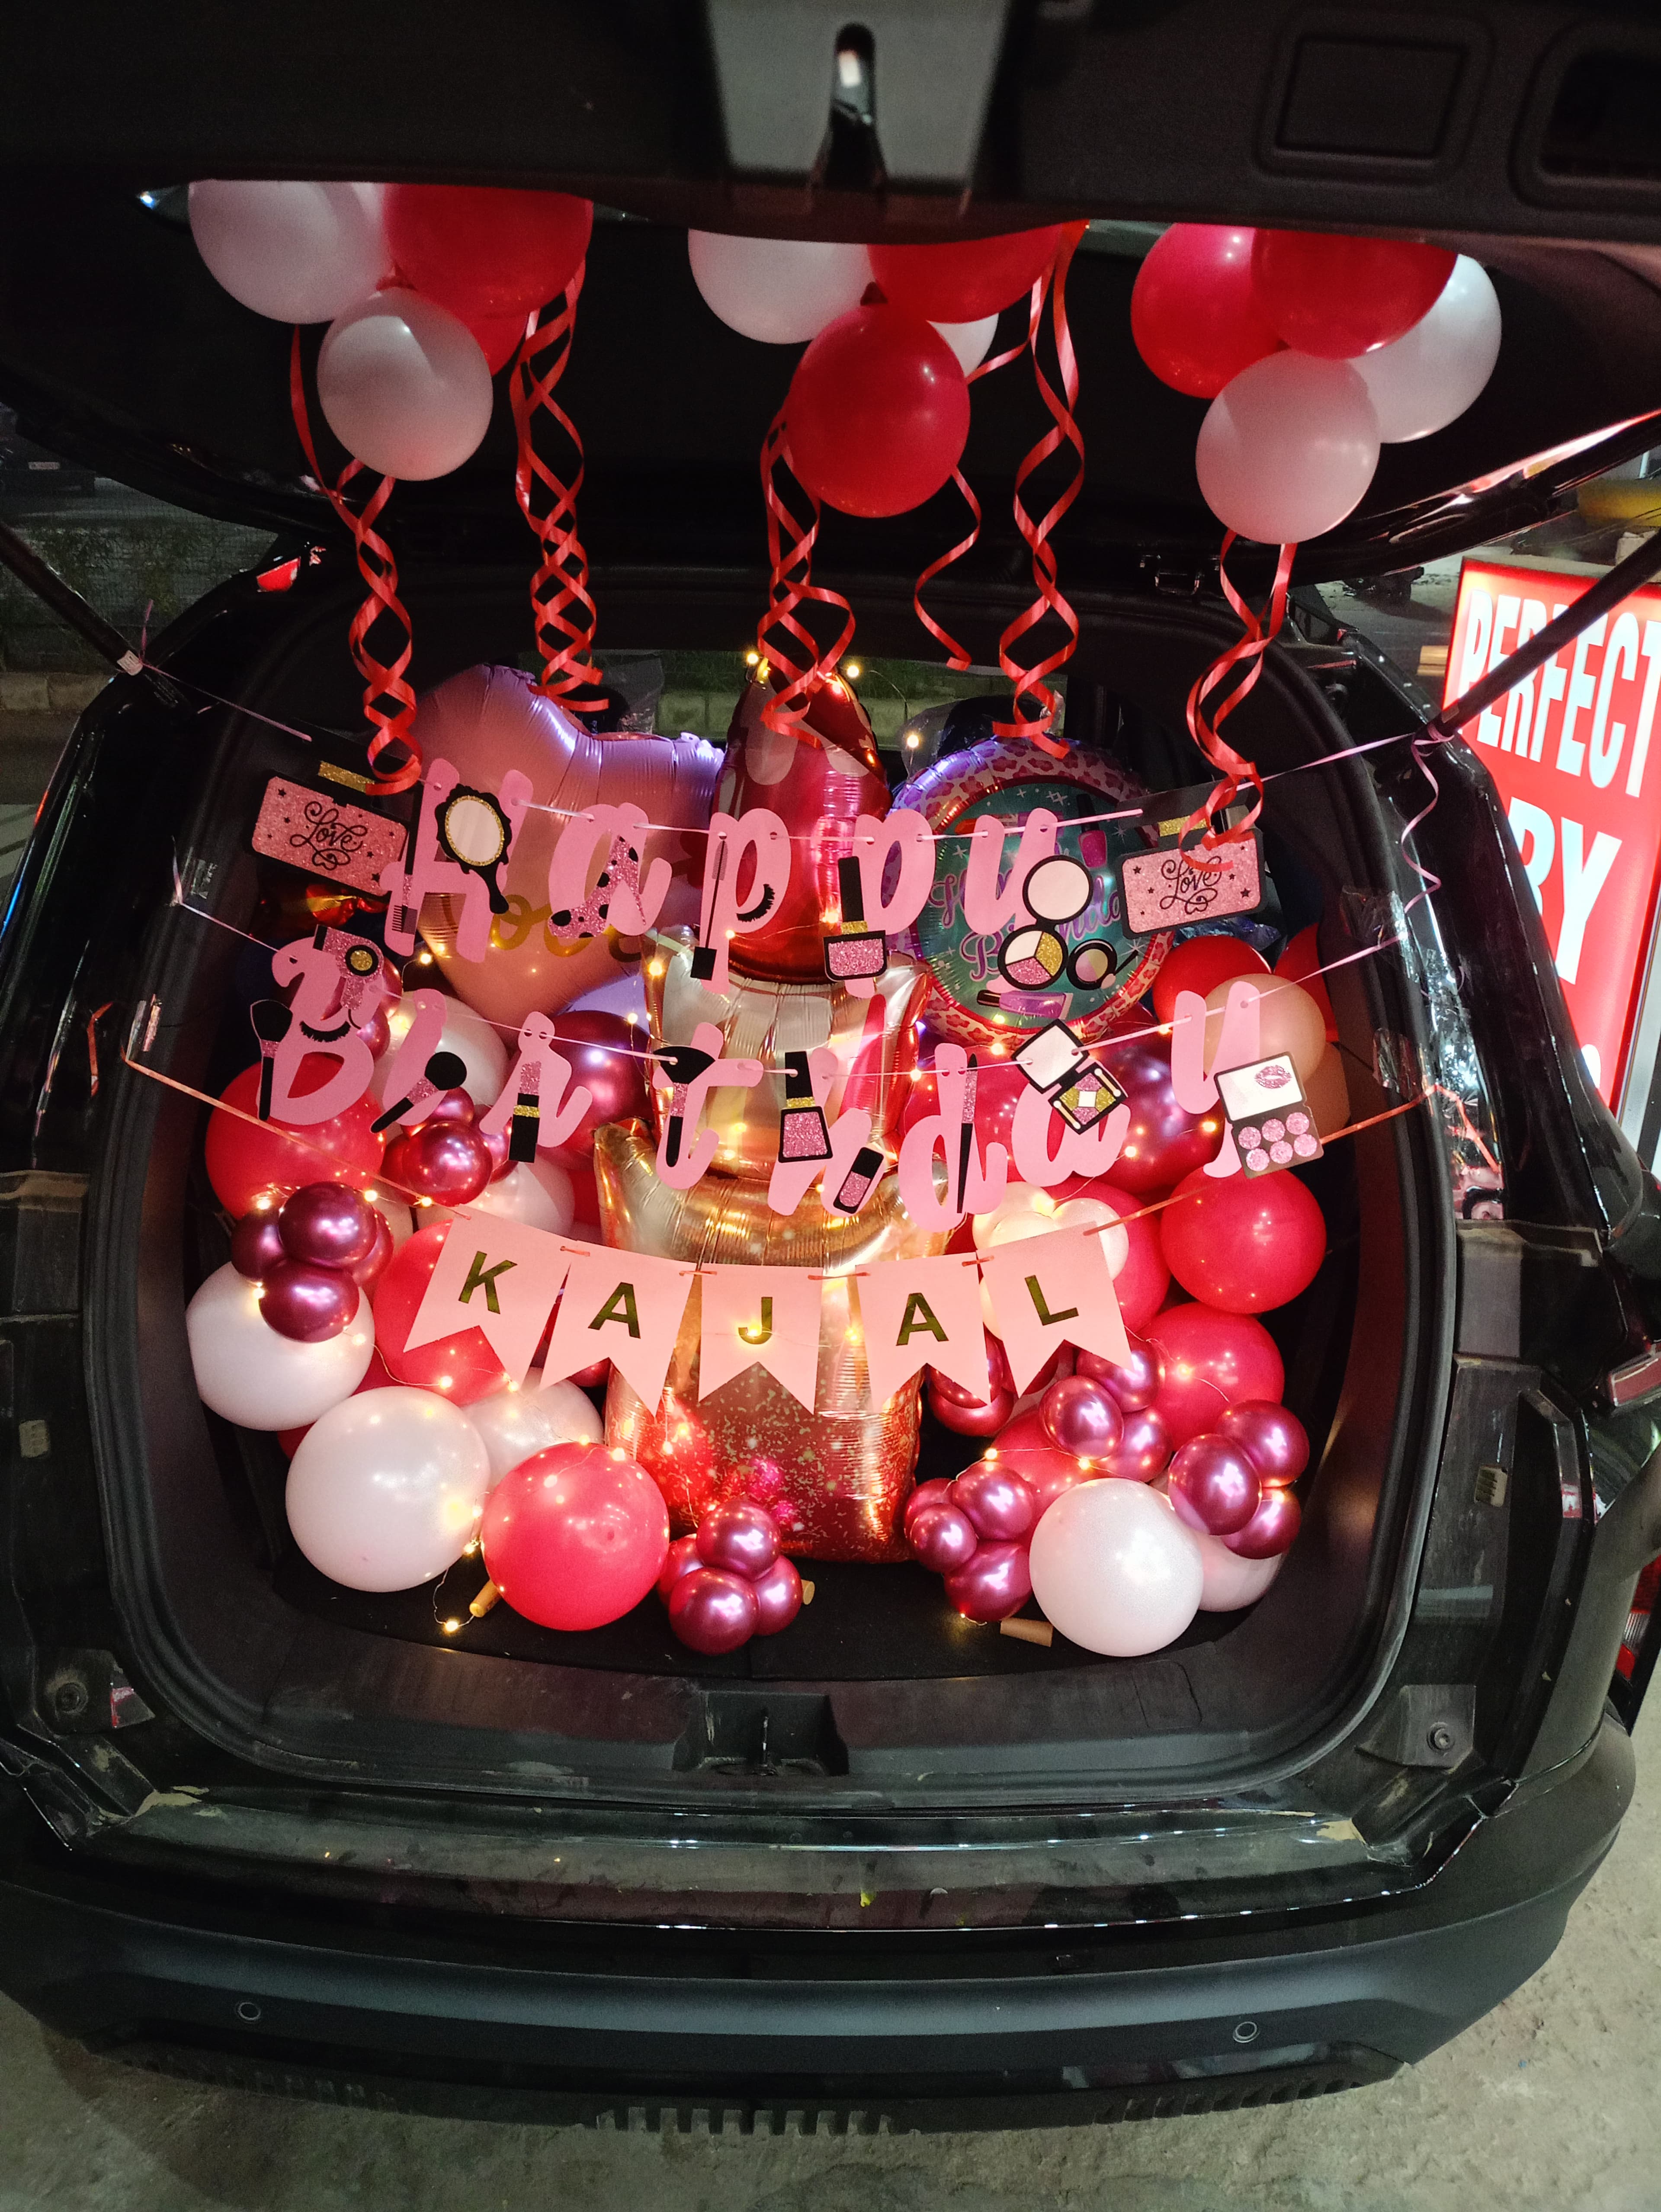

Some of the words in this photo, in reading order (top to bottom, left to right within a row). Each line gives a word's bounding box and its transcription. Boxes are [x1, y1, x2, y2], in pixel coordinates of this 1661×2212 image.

[1457, 589, 1661, 798] PERFECT
[290, 801, 368, 870] Love
[380, 758, 1058, 999] Happy
[1159, 856, 1222, 915] Love
[257, 935, 1260, 1233] Birthday
[458, 1251, 1079, 1347] KAJAL
